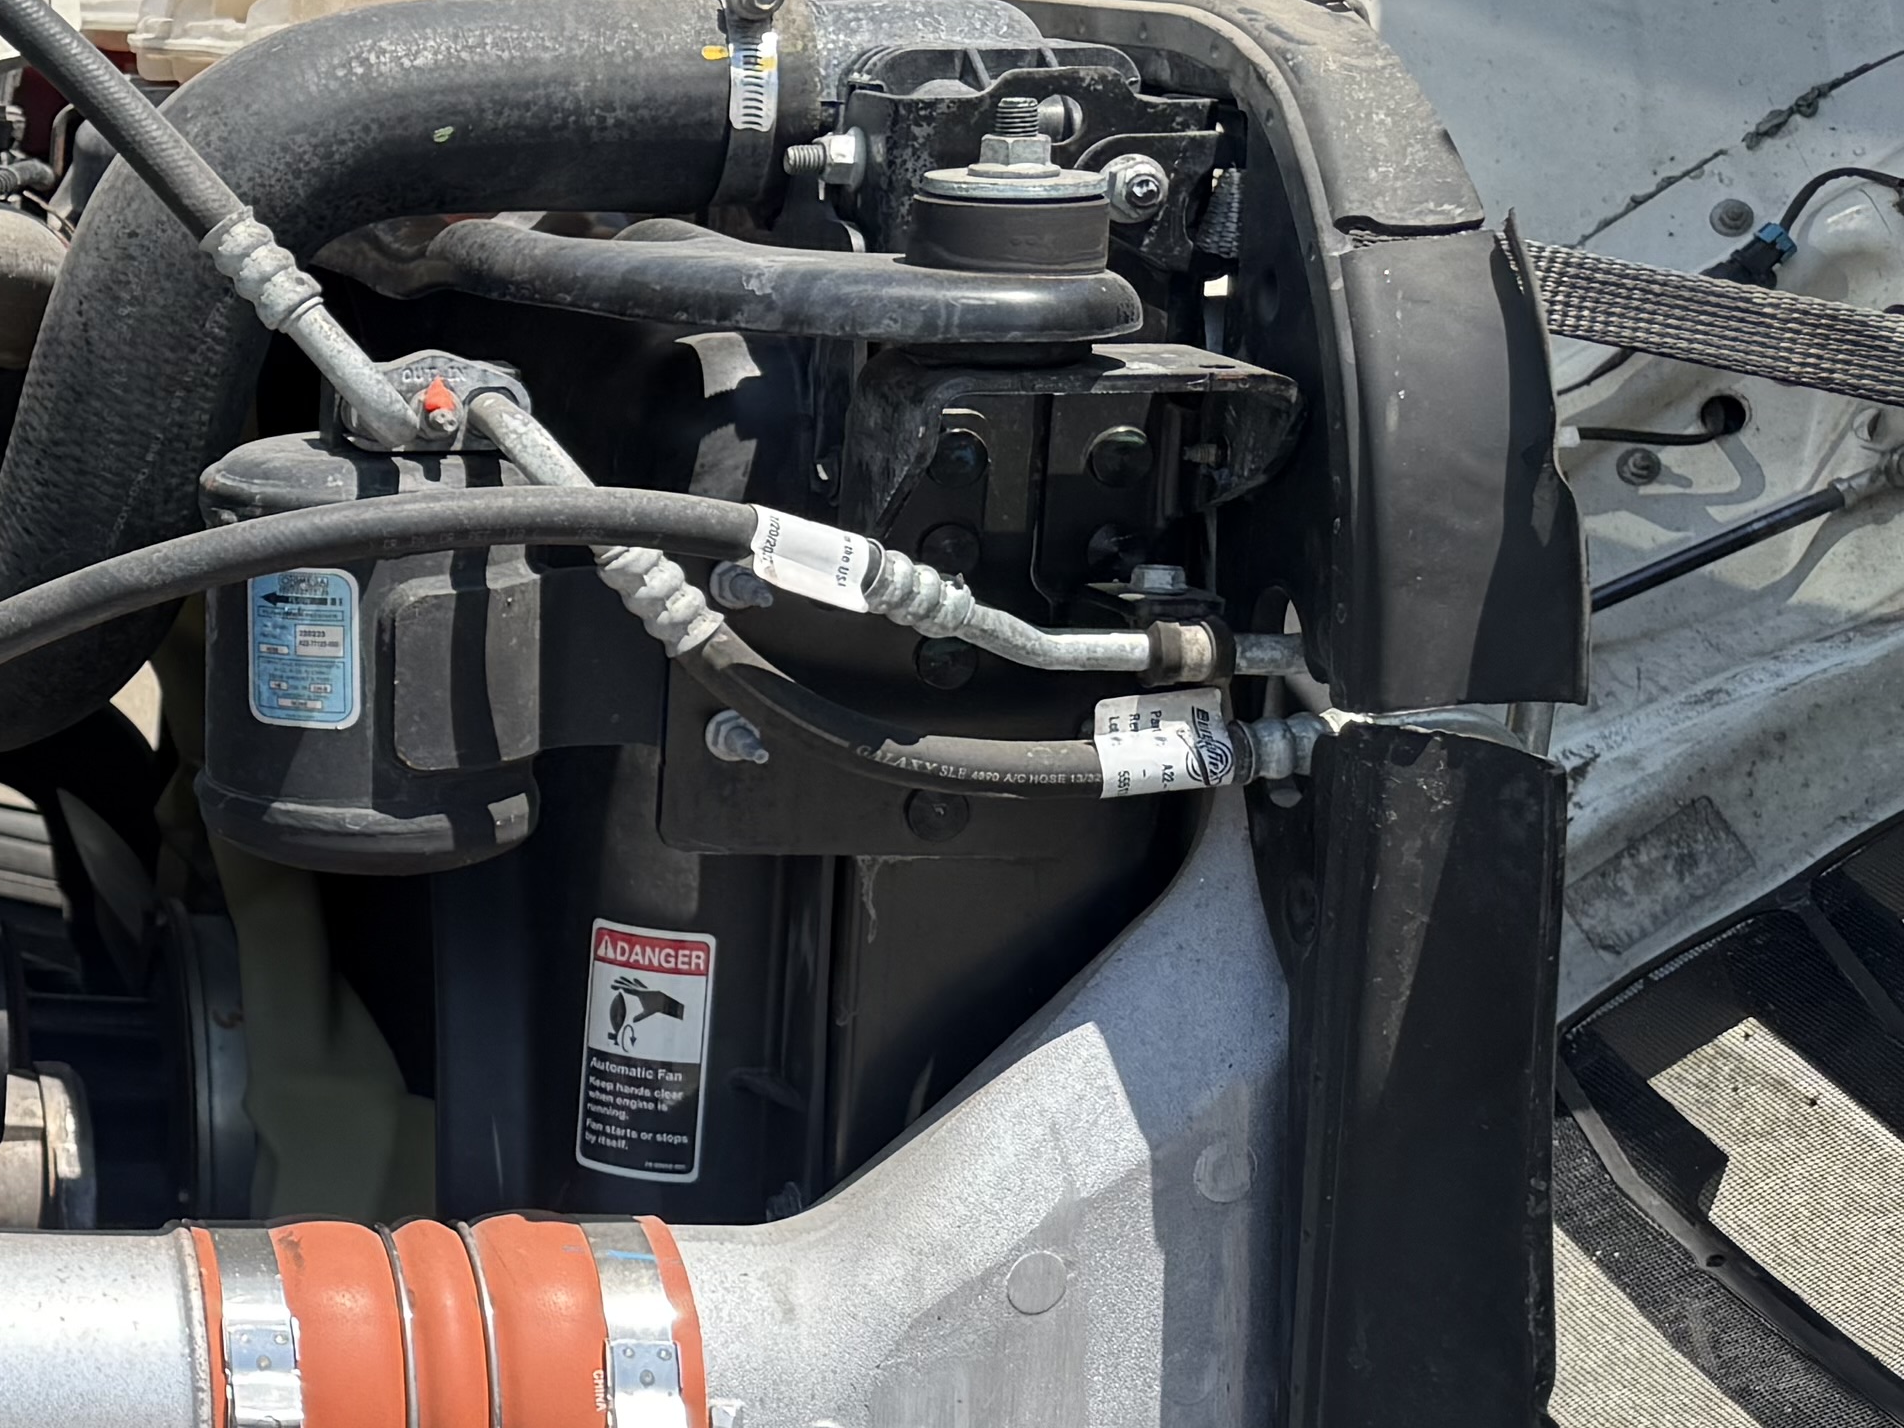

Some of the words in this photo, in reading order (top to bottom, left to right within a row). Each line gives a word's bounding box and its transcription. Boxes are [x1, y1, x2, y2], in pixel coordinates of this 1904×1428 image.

[402, 366, 439, 383] OUT
[1149, 709, 1162, 733] Part
[856, 744, 939, 772] GALAXY
[939, 764, 966, 780] SLE
[1002, 772, 1026, 784] A/C
[1028, 773, 1066, 784] HOSE
[616, 940, 705, 971] DANGER
[589, 1056, 654, 1080] Automatic
[657, 1068, 683, 1082] Fan
[588, 1075, 614, 1091] Keep
[615, 1082, 652, 1098] hands
[653, 1088, 684, 1101] clear
[588, 1090, 614, 1104] when
[615, 1096, 655, 1110] engine
[657, 1101, 668, 1112] is
[586, 1102, 629, 1121] running.
[584, 1131, 597, 1144] by
[597, 1134, 629, 1150] itself.
[585, 1117, 603, 1132] Fan
[605, 1125, 638, 1139] starts
[639, 1132, 654, 1141] or
[655, 1132, 689, 1145] stops
[592, 1368, 607, 1412] CHINA
